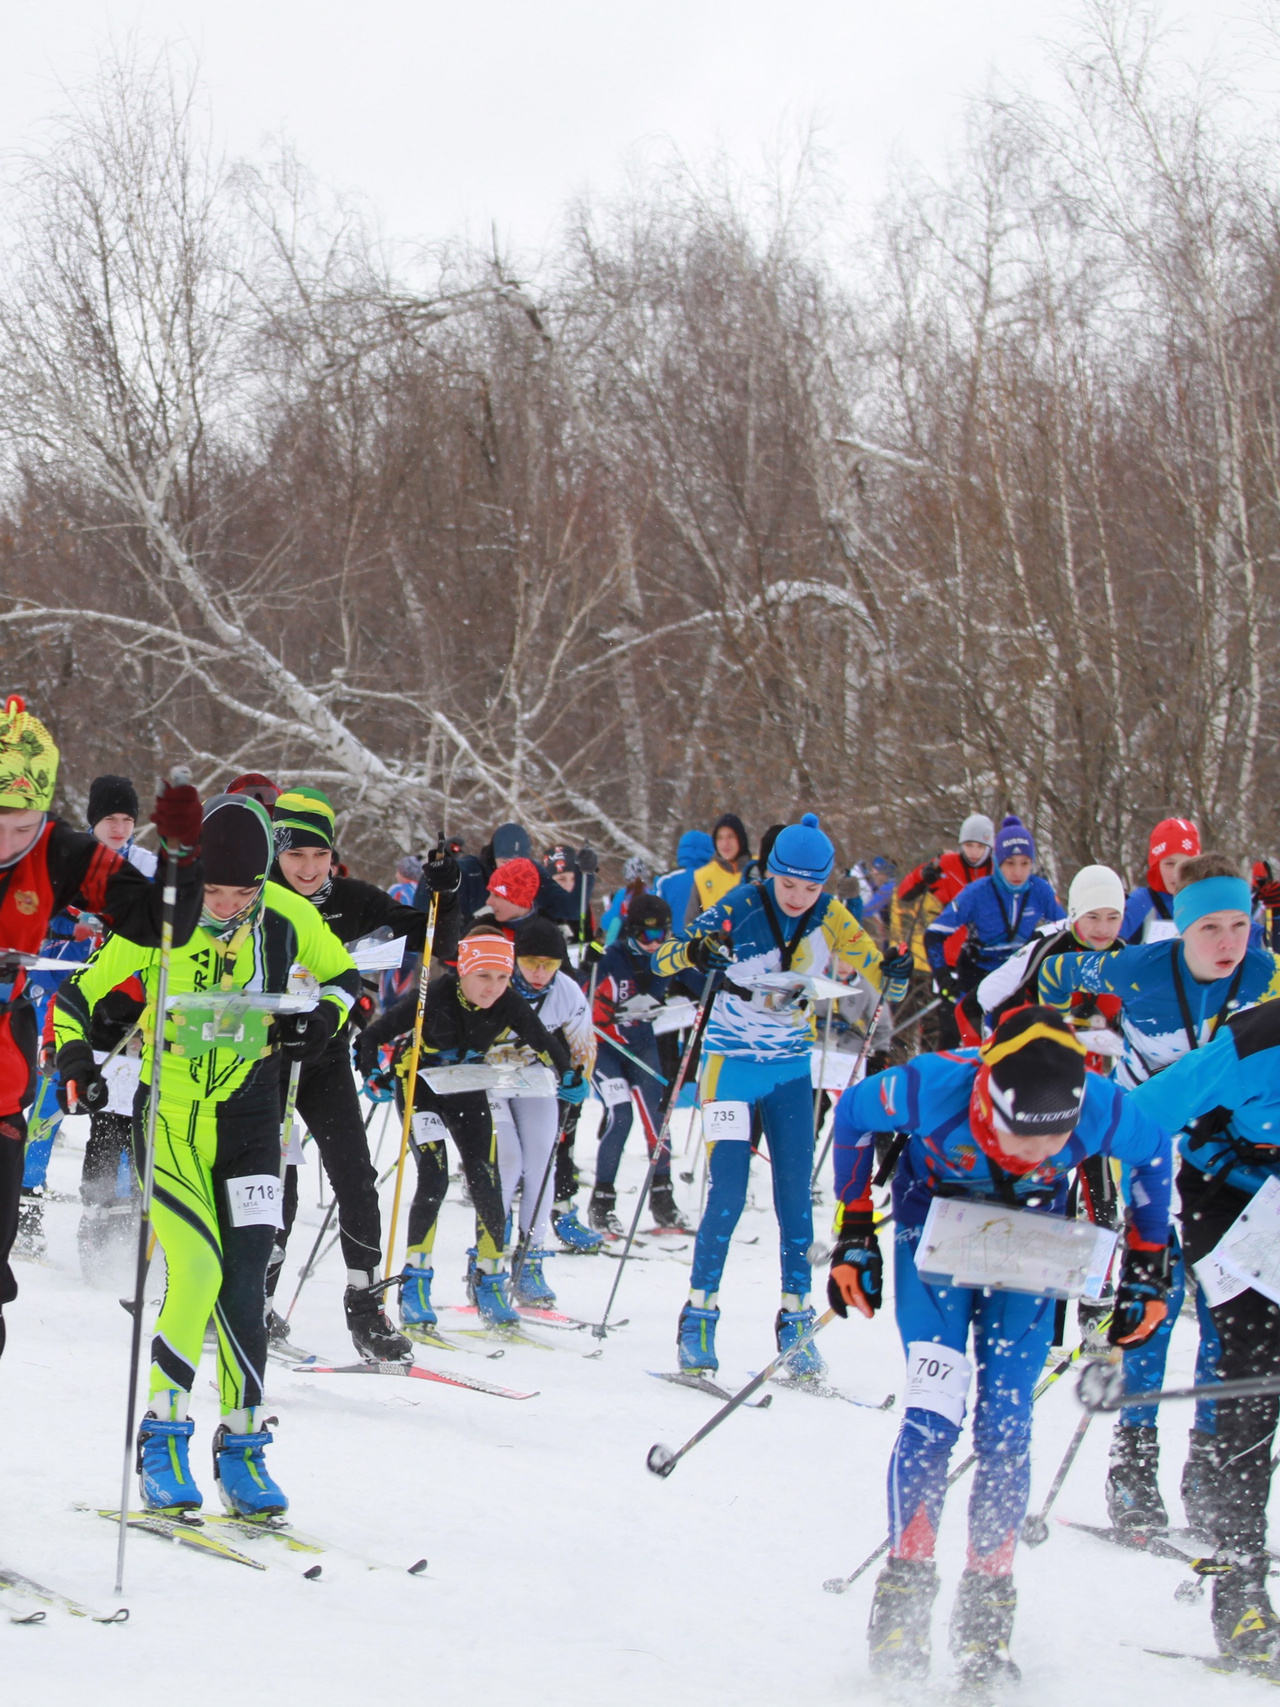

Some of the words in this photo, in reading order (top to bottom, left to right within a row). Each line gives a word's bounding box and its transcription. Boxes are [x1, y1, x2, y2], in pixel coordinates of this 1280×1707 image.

[713, 1110, 735, 1122] 735
[245, 1185, 274, 1200] 718
[378, 1363, 408, 1377] ROSSIGNOL
[917, 1357, 954, 1381] 707
